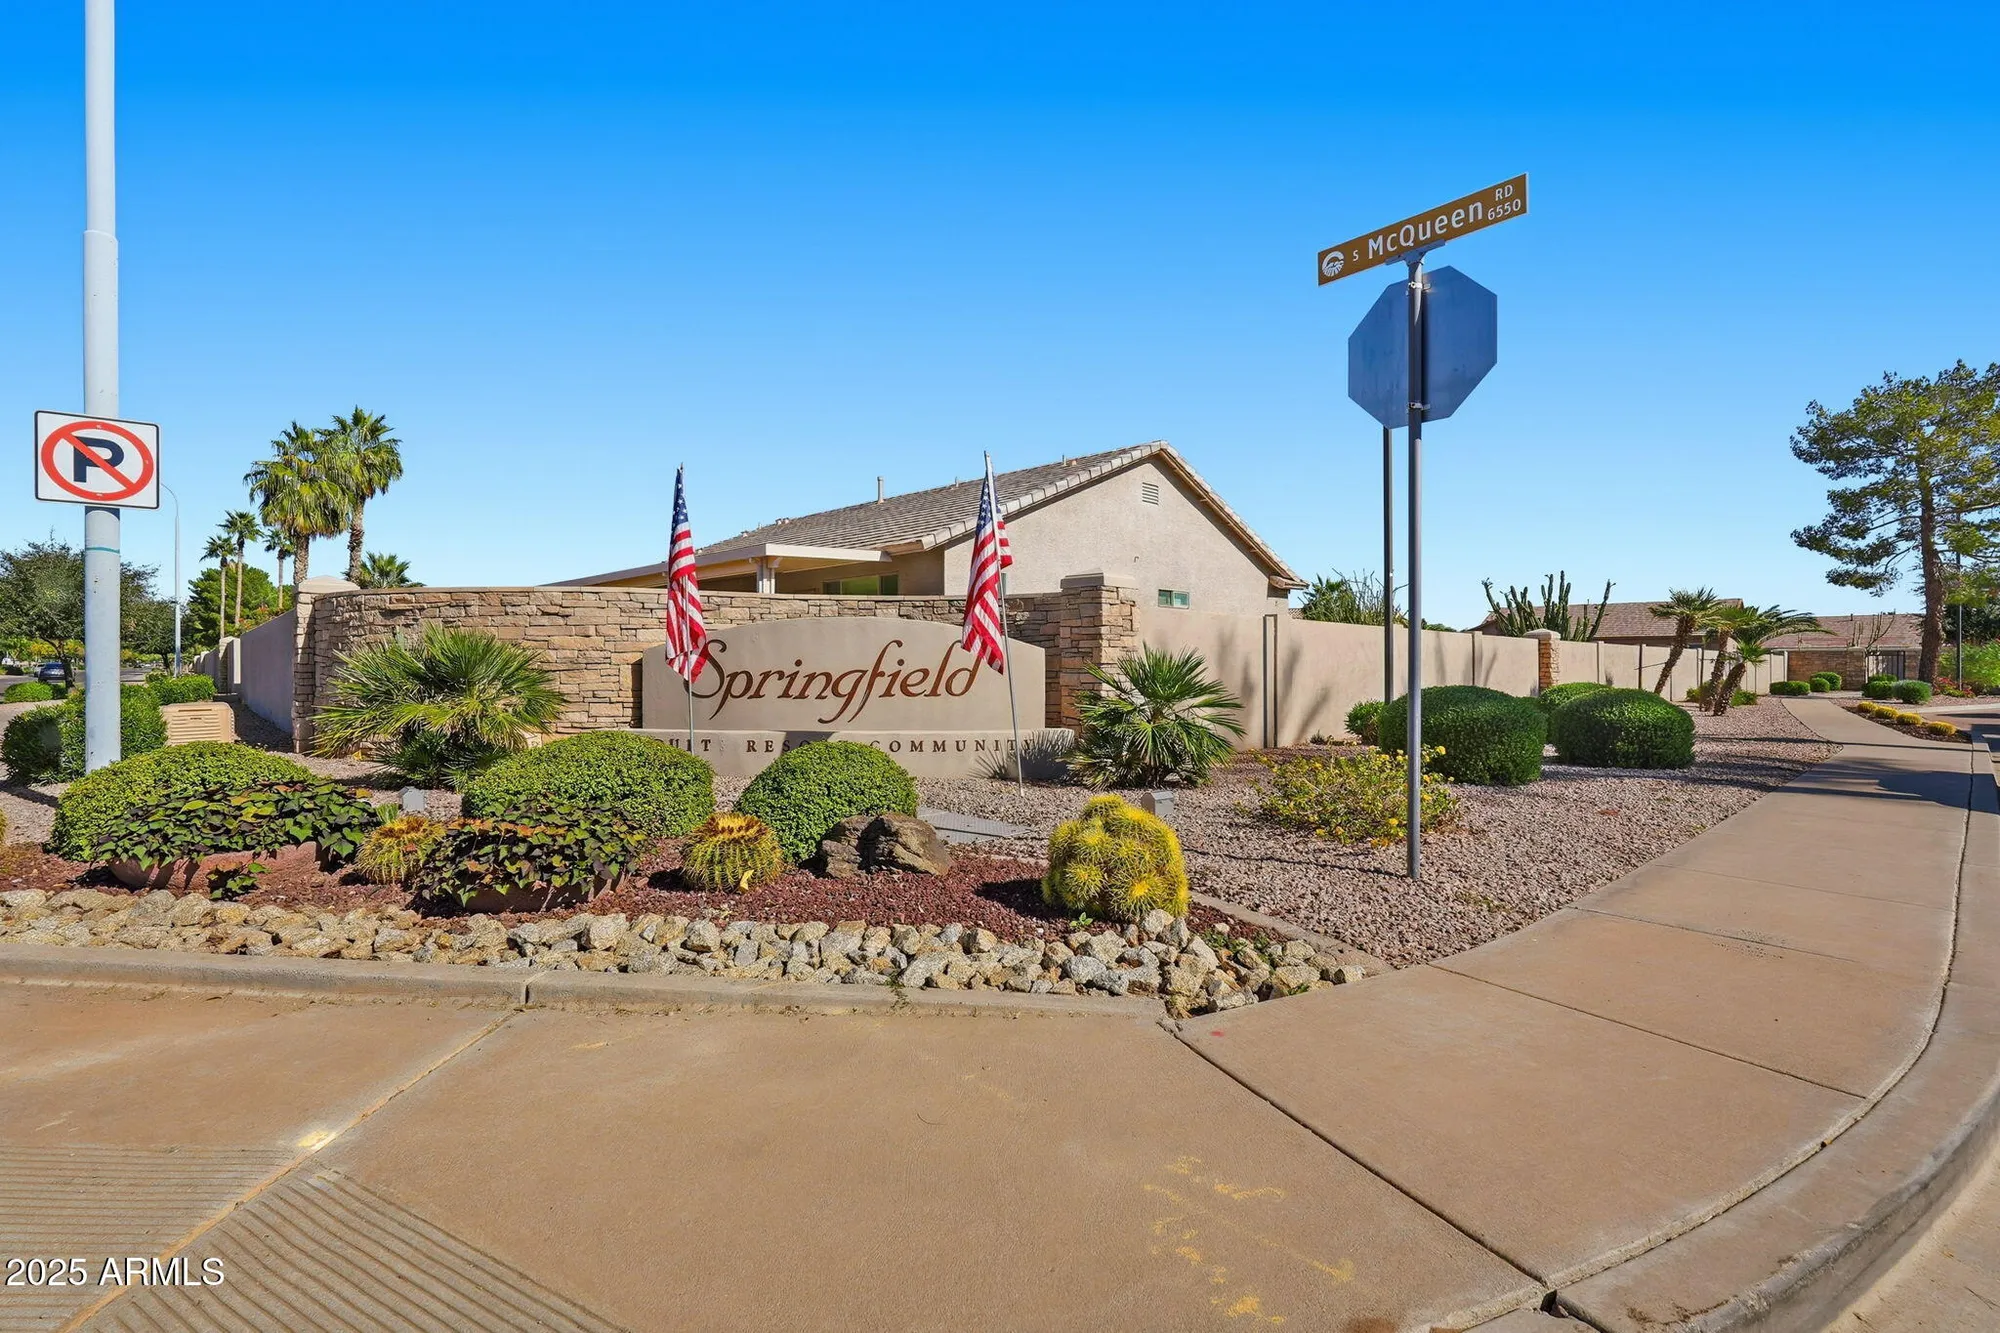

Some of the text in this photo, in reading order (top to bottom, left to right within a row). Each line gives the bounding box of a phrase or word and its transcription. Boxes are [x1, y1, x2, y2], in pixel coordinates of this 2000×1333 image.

[1487, 198, 1522, 221] 6550
[1495, 184, 1513, 201] RD
[1352, 200, 1483, 262] S McQueen
[683, 639, 986, 724] Springfield
